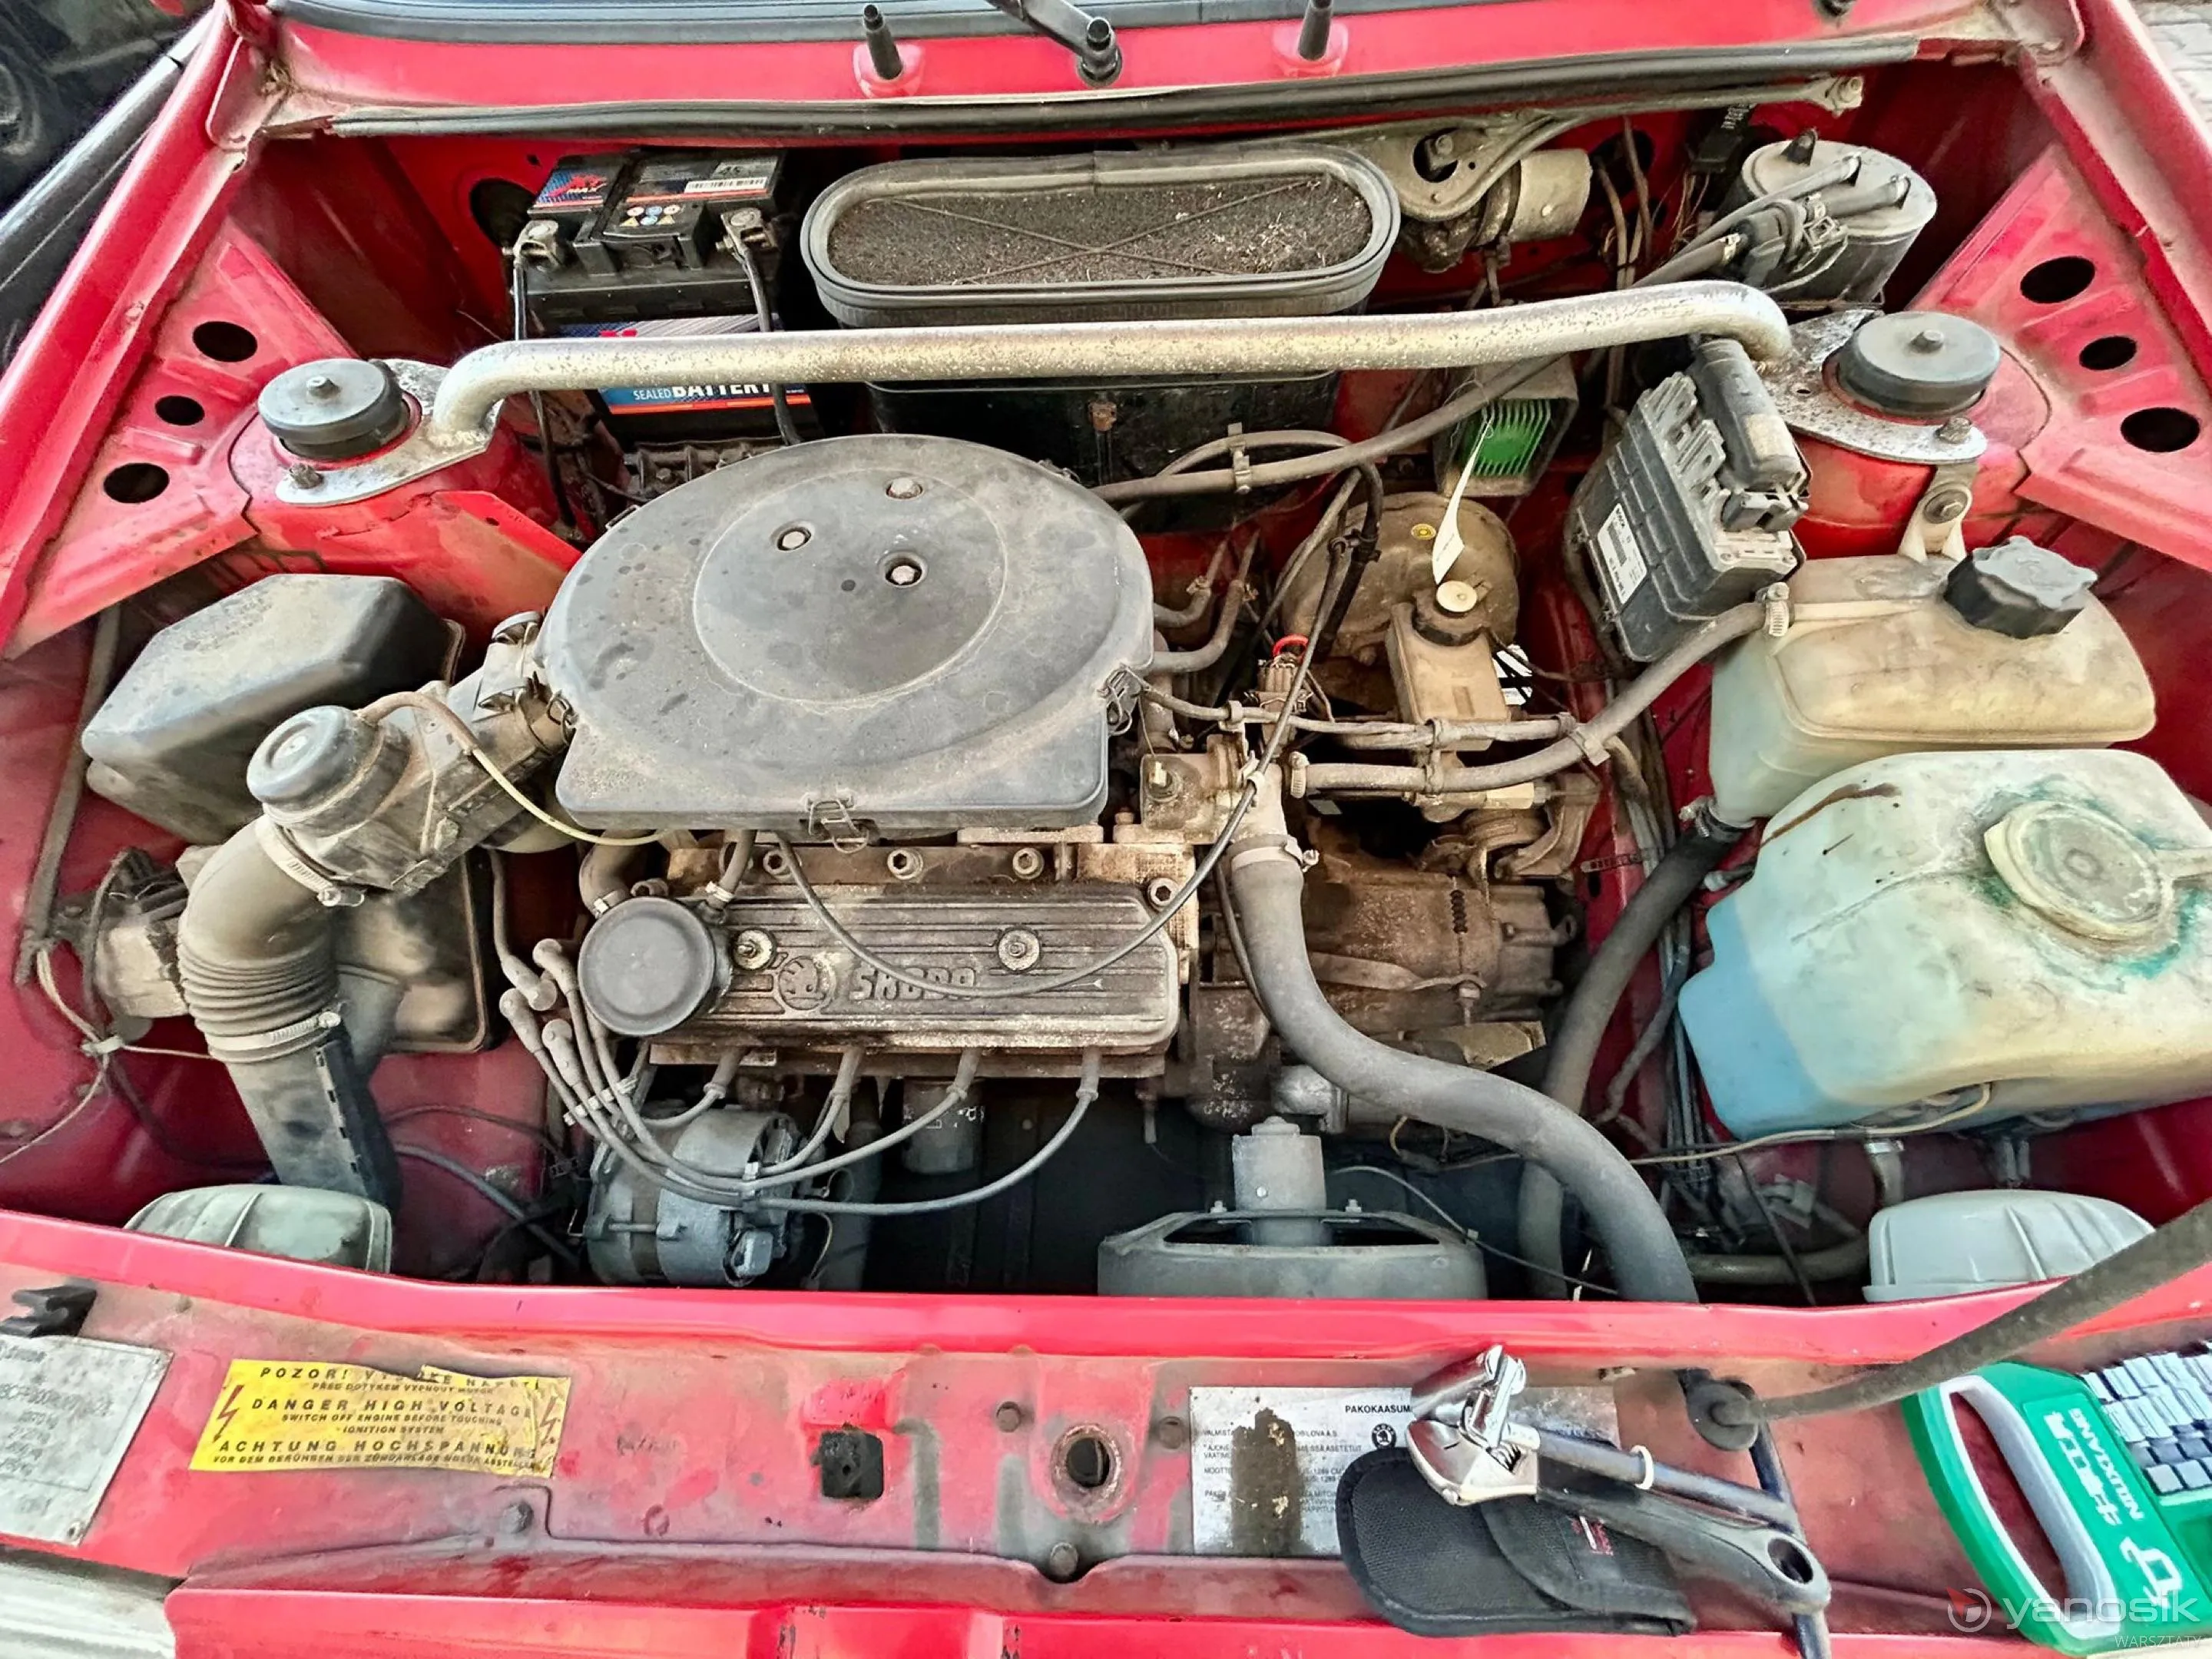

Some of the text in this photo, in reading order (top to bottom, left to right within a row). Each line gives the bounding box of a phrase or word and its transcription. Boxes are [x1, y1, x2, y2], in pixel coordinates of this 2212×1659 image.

[633, 387, 671, 400] SEALED
[260, 1367, 349, 1379] POZOR!
[252, 1399, 349, 1411] DANGER
[365, 1399, 422, 1411] HIGH
[1345, 1405, 1412, 1413] PAKOKAASUM
[282, 1413, 327, 1422] SWITCH
[404, 1414, 446, 1422] BEFORE
[451, 1415, 502, 1426] TOUCHING
[343, 1426, 445, 1434] IGNITION SYSTEM
[220, 1440, 338, 1452] ACHTUNG
